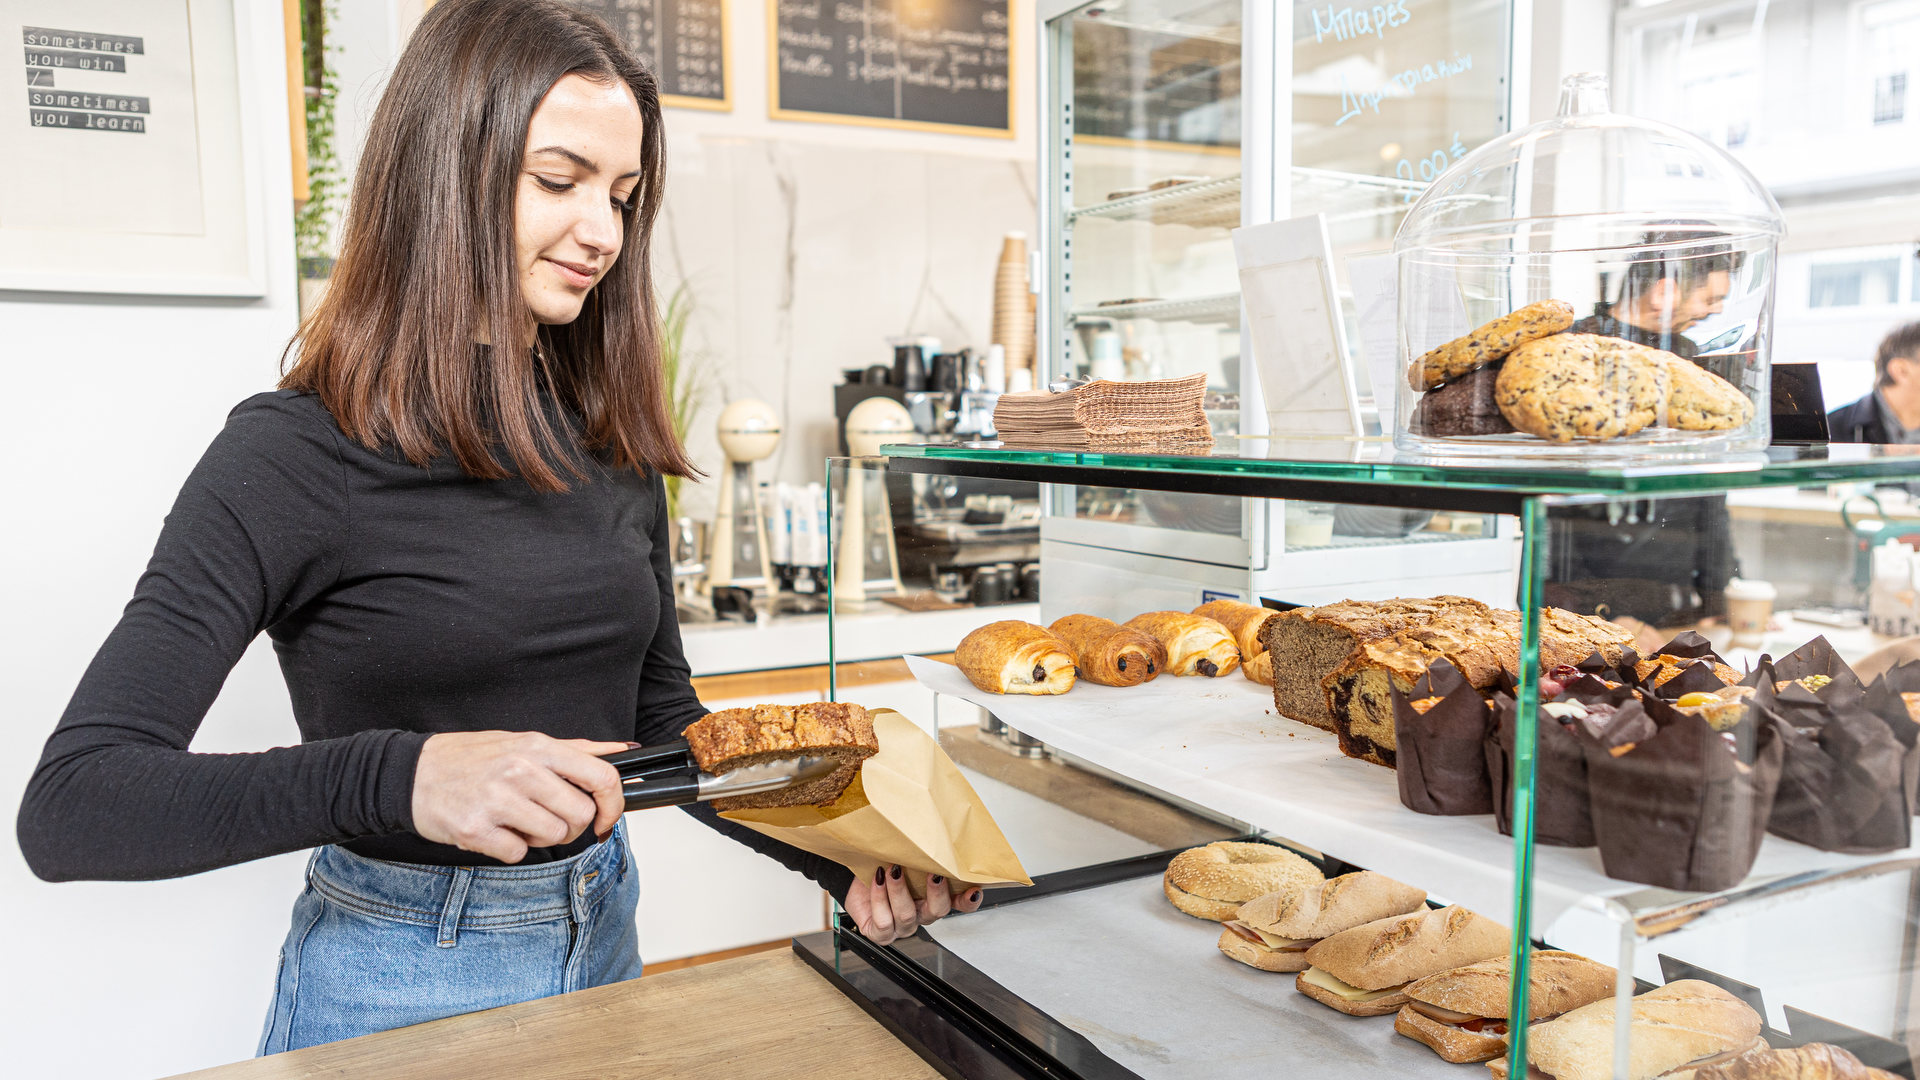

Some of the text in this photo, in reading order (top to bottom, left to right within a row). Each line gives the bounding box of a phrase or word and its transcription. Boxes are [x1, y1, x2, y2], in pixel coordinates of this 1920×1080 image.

[28, 32, 135, 54] sometimes
[28, 54, 114, 71] you win
[30, 71, 41, 86] /
[33, 92, 141, 112] sometimes
[34, 112, 144, 131] you learn
